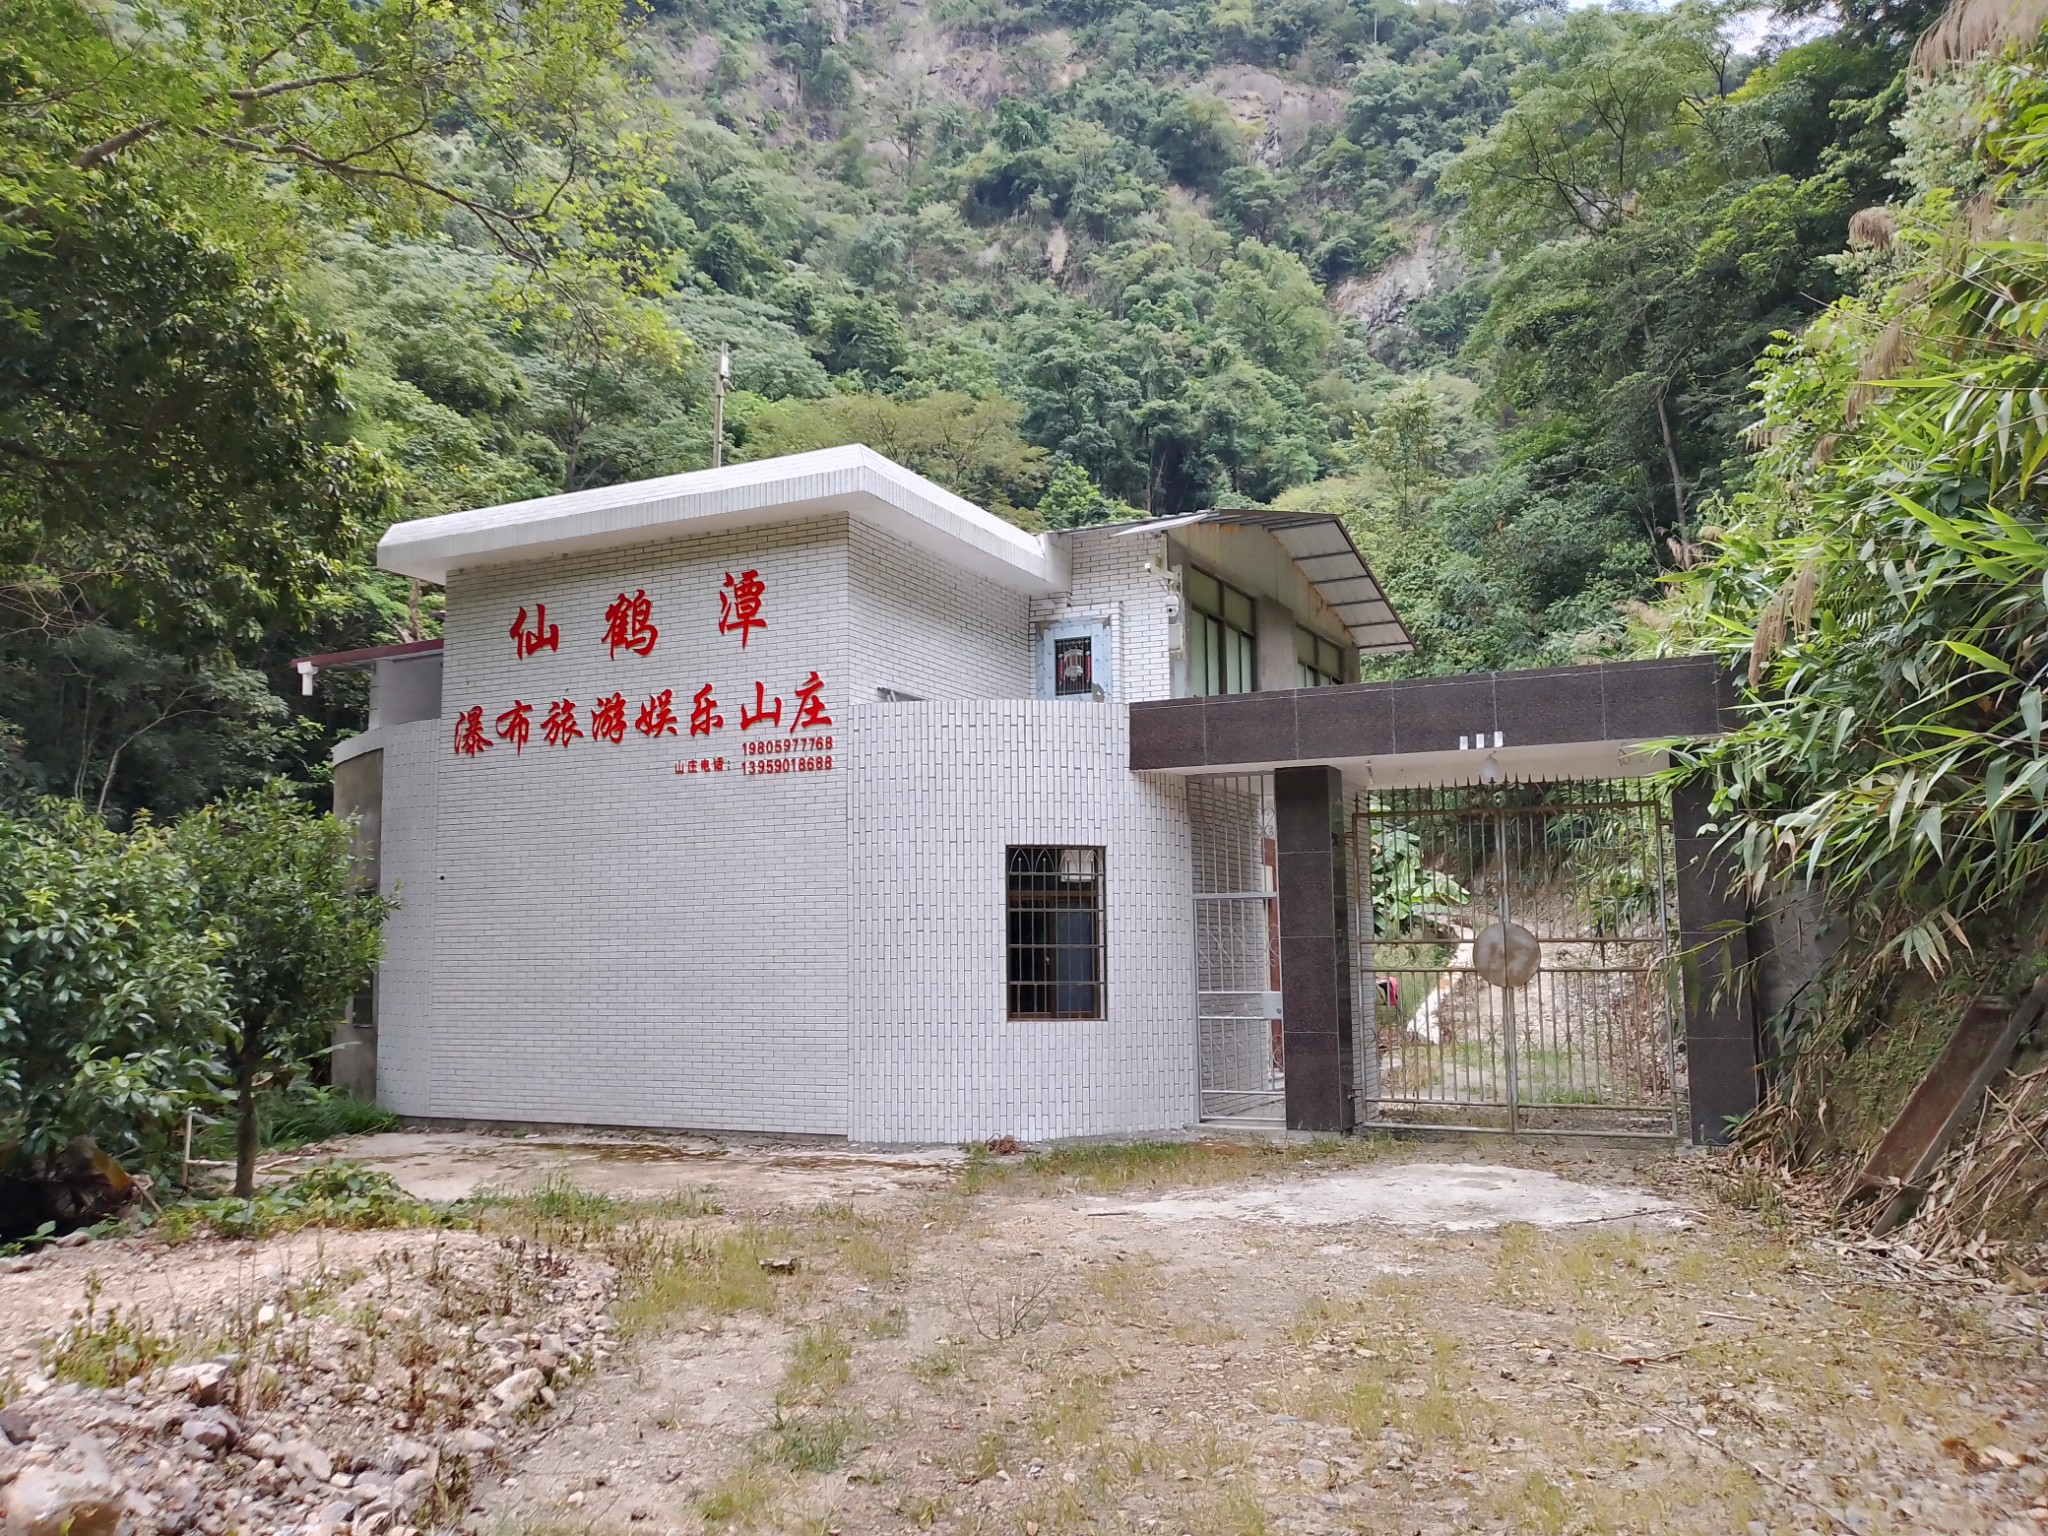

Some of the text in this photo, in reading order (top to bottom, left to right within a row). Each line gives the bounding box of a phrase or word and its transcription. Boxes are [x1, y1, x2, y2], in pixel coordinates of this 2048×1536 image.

[509, 569, 768, 659] 仙鹤潭
[454, 671, 833, 756] 瀑布旅游娱乐山庄
[741, 755, 833, 776] 13959018688
[742, 736, 833, 756] 19805977768
